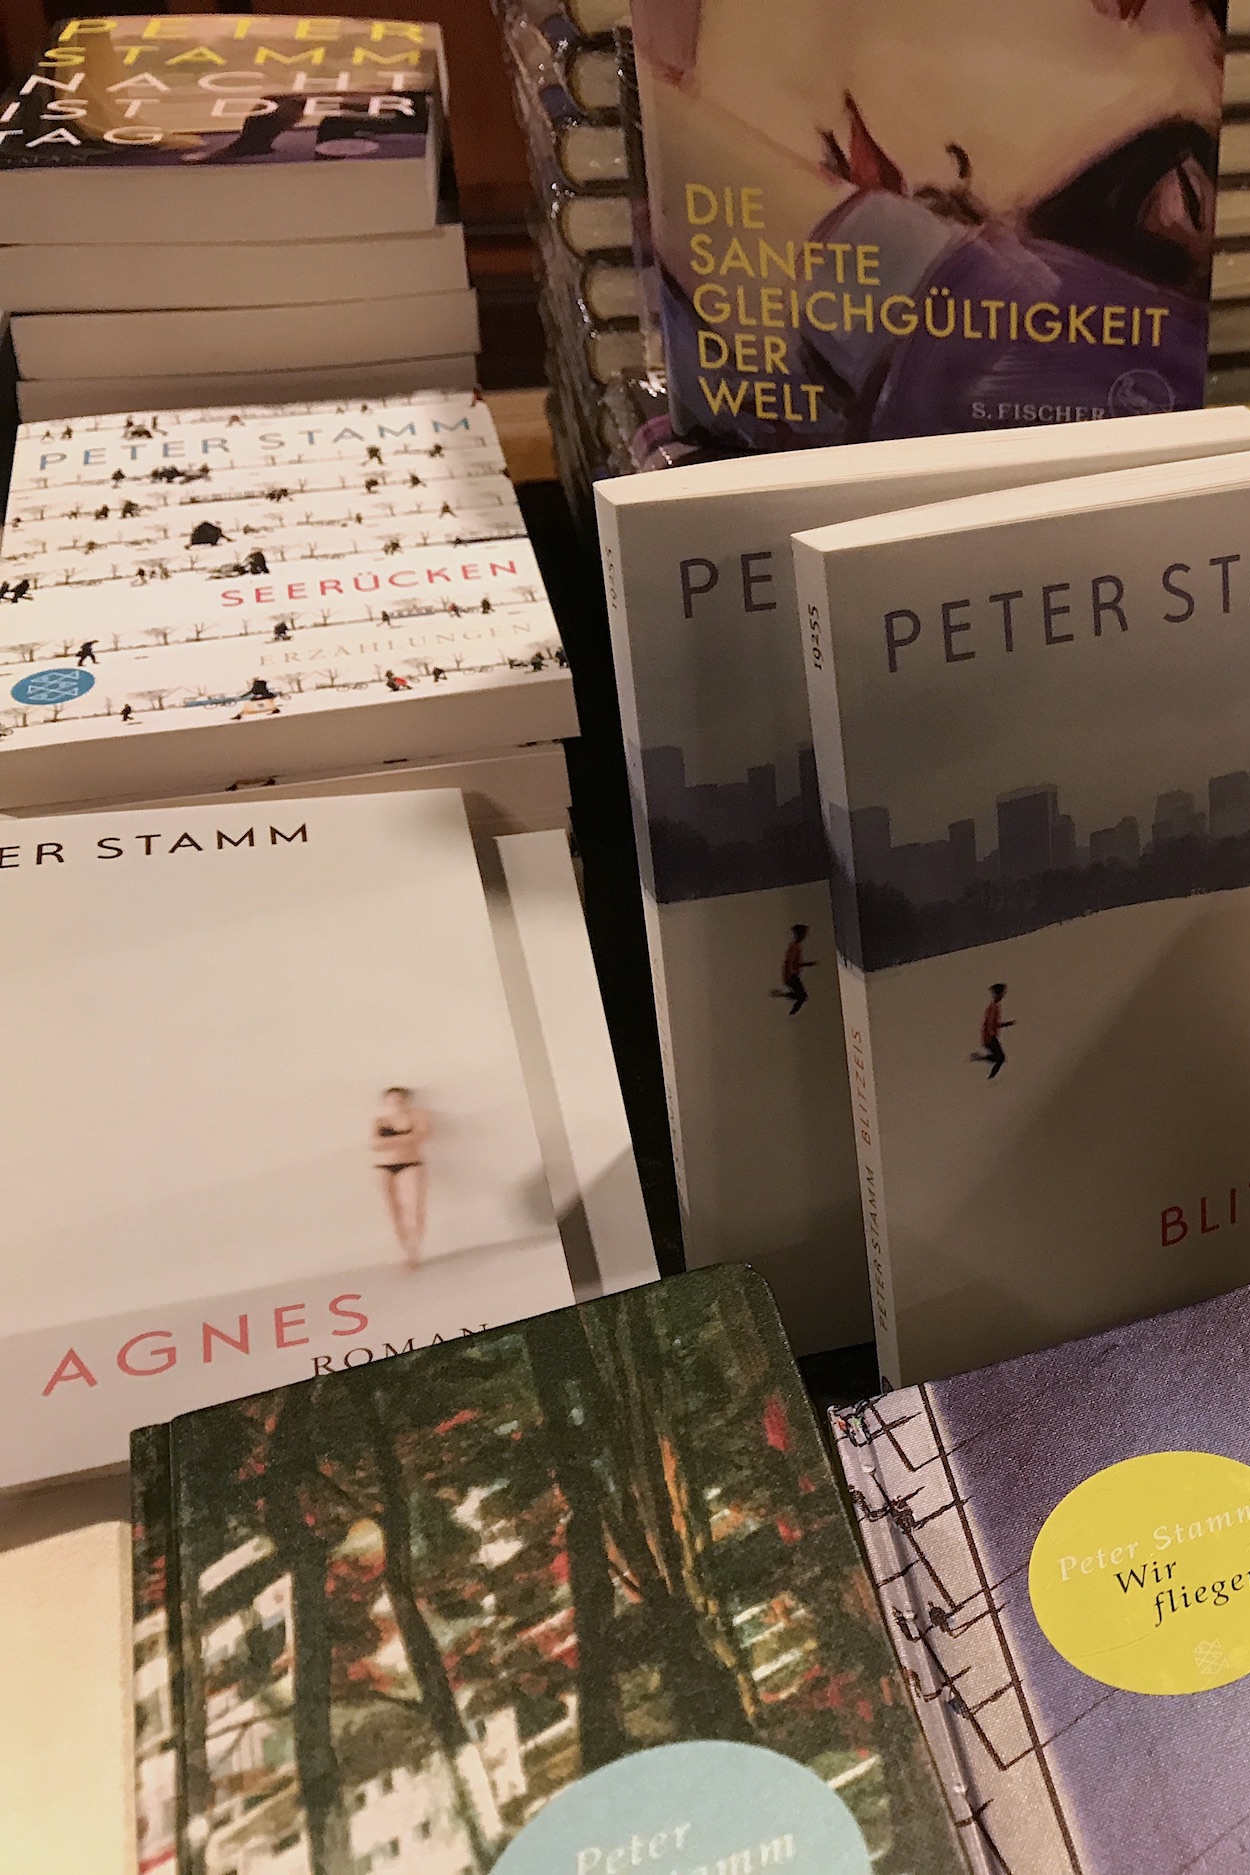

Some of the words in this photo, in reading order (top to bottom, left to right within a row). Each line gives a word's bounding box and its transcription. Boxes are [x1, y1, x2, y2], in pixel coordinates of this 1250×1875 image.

[57, 18, 424, 43] PETER
[42, 45, 421, 68] STAMM
[20, 71, 421, 94] NACHT
[0, 98, 159, 122] IST
[210, 96, 415, 119] DER
[685, 184, 764, 229] DIE
[688, 234, 881, 286] SANFTE
[692, 286, 1170, 348] GLEICHGÜLTIGKEIT
[698, 333, 789, 375] DER
[697, 377, 825, 423] WELT
[971, 401, 992, 420] S.
[997, 402, 1105, 421] FISCHER
[39, 434, 230, 472] PETER
[258, 416, 472, 452] STAMM
[219, 559, 519, 608] SEERÜCKEN
[807, 603, 825, 671] 19255
[882, 574, 1129, 674] PETER
[96, 822, 310, 861] STAMM
[851, 1028, 872, 1147] BLITZEIS
[865, 1165, 882, 1257] STAMM
[876, 1259, 888, 1332] PETER
[42, 1293, 370, 1397] AGNES
[1056, 1538, 1140, 1582] Peter
[1113, 1557, 1178, 1595] Wir
[576, 1823, 692, 1875] Peter
